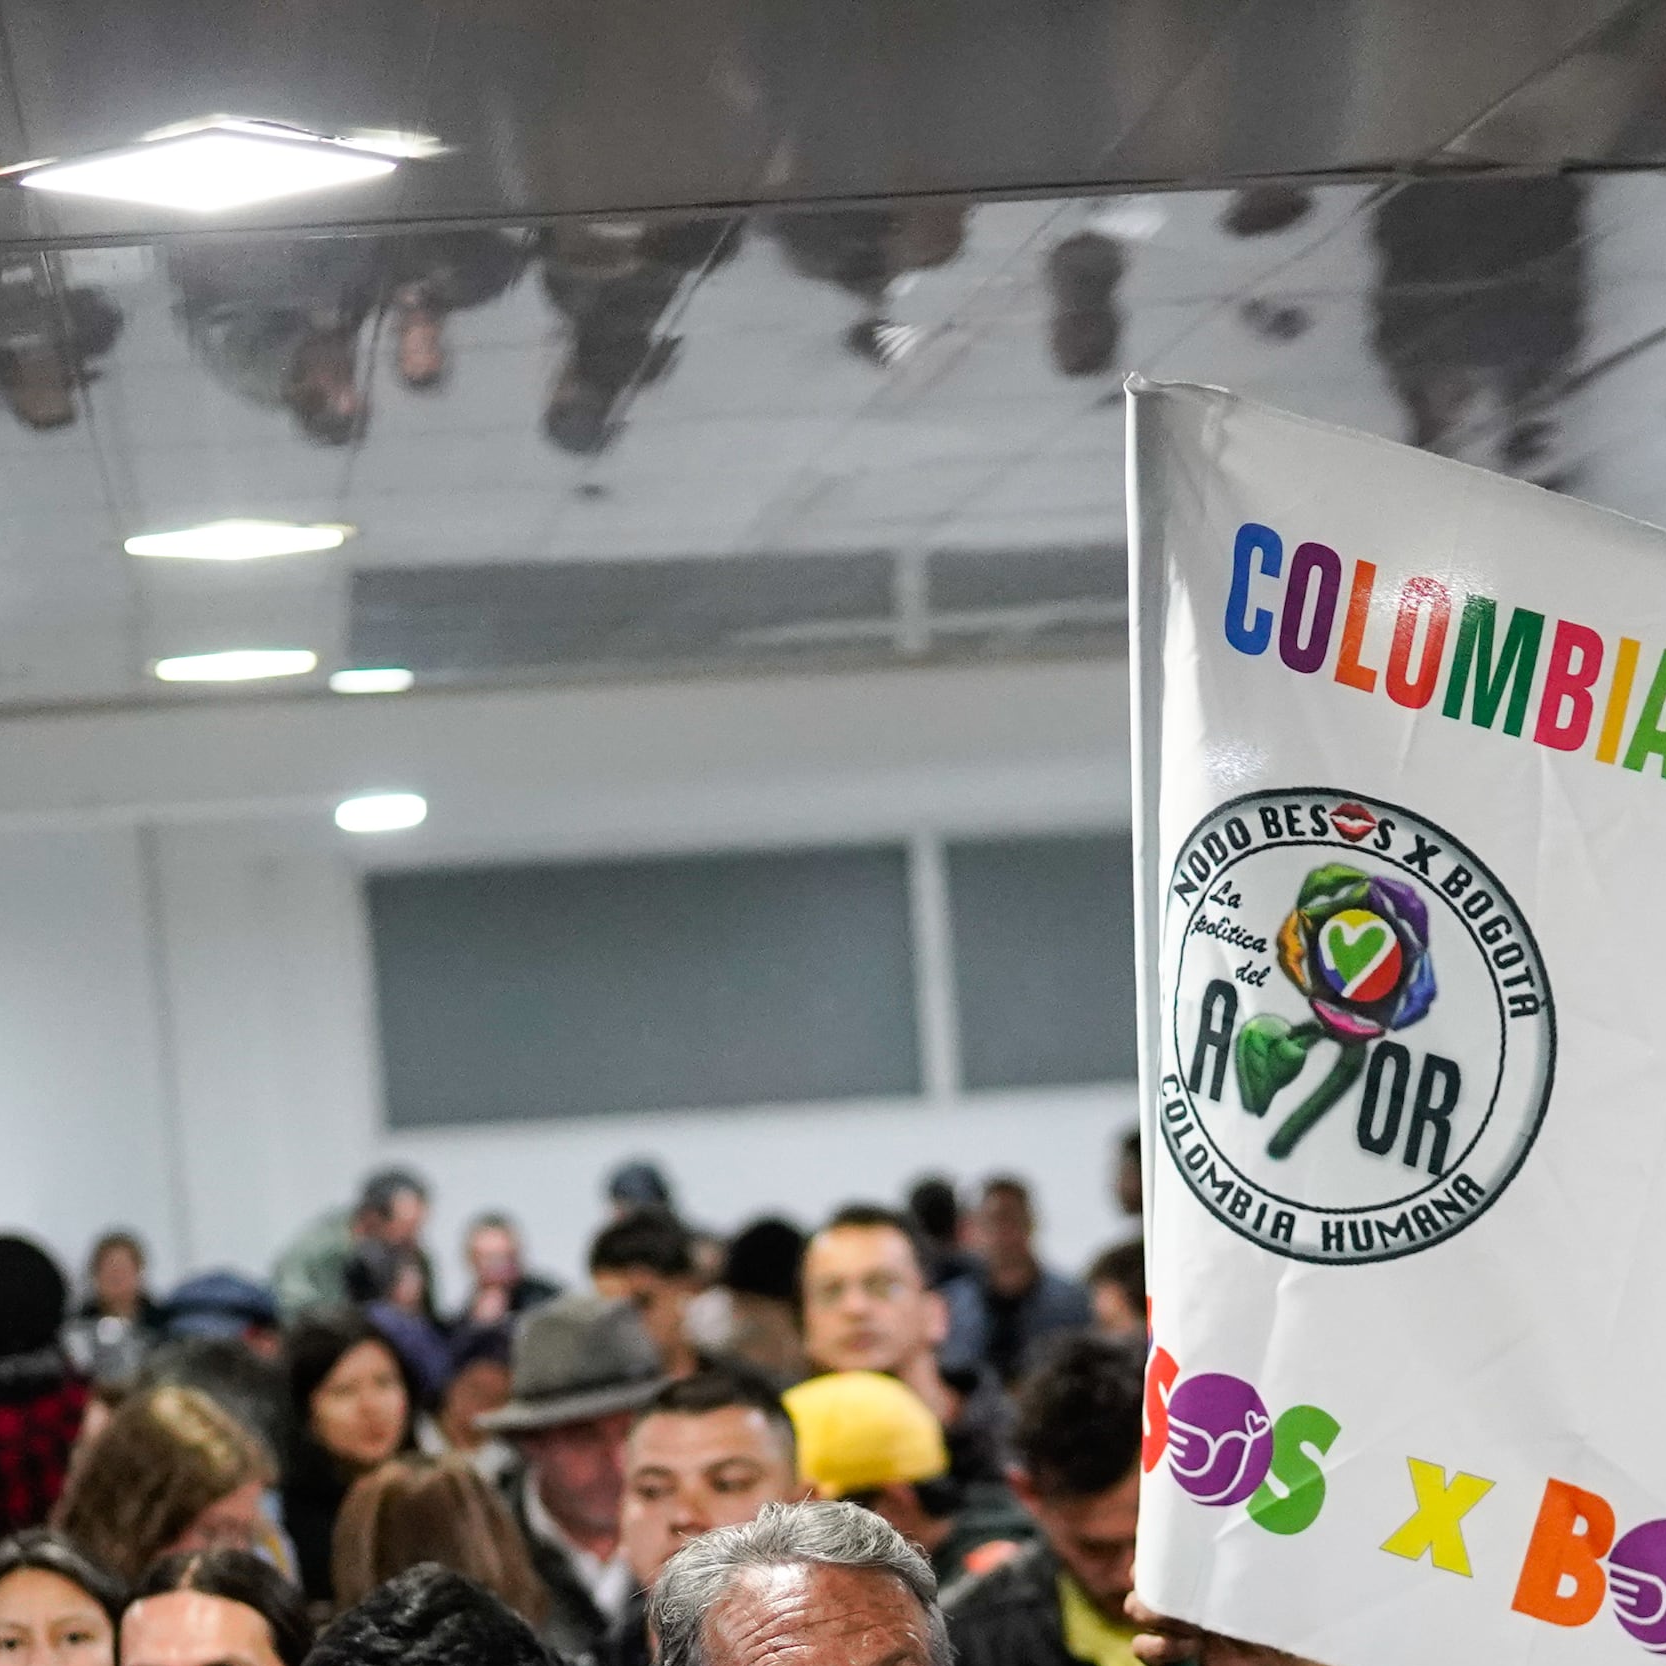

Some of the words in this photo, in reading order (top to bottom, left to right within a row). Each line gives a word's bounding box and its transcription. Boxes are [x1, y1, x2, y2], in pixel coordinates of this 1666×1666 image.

[1173, 817, 1252, 906] NODO
[1403, 834, 1441, 875] X
[1209, 880, 1242, 909] La
[1235, 960, 1271, 987] del
[1161, 1072, 1296, 1243] COLOMBIA
[1322, 1173, 1486, 1251] HUMANA
[1142, 1296, 1341, 1536] SOS
